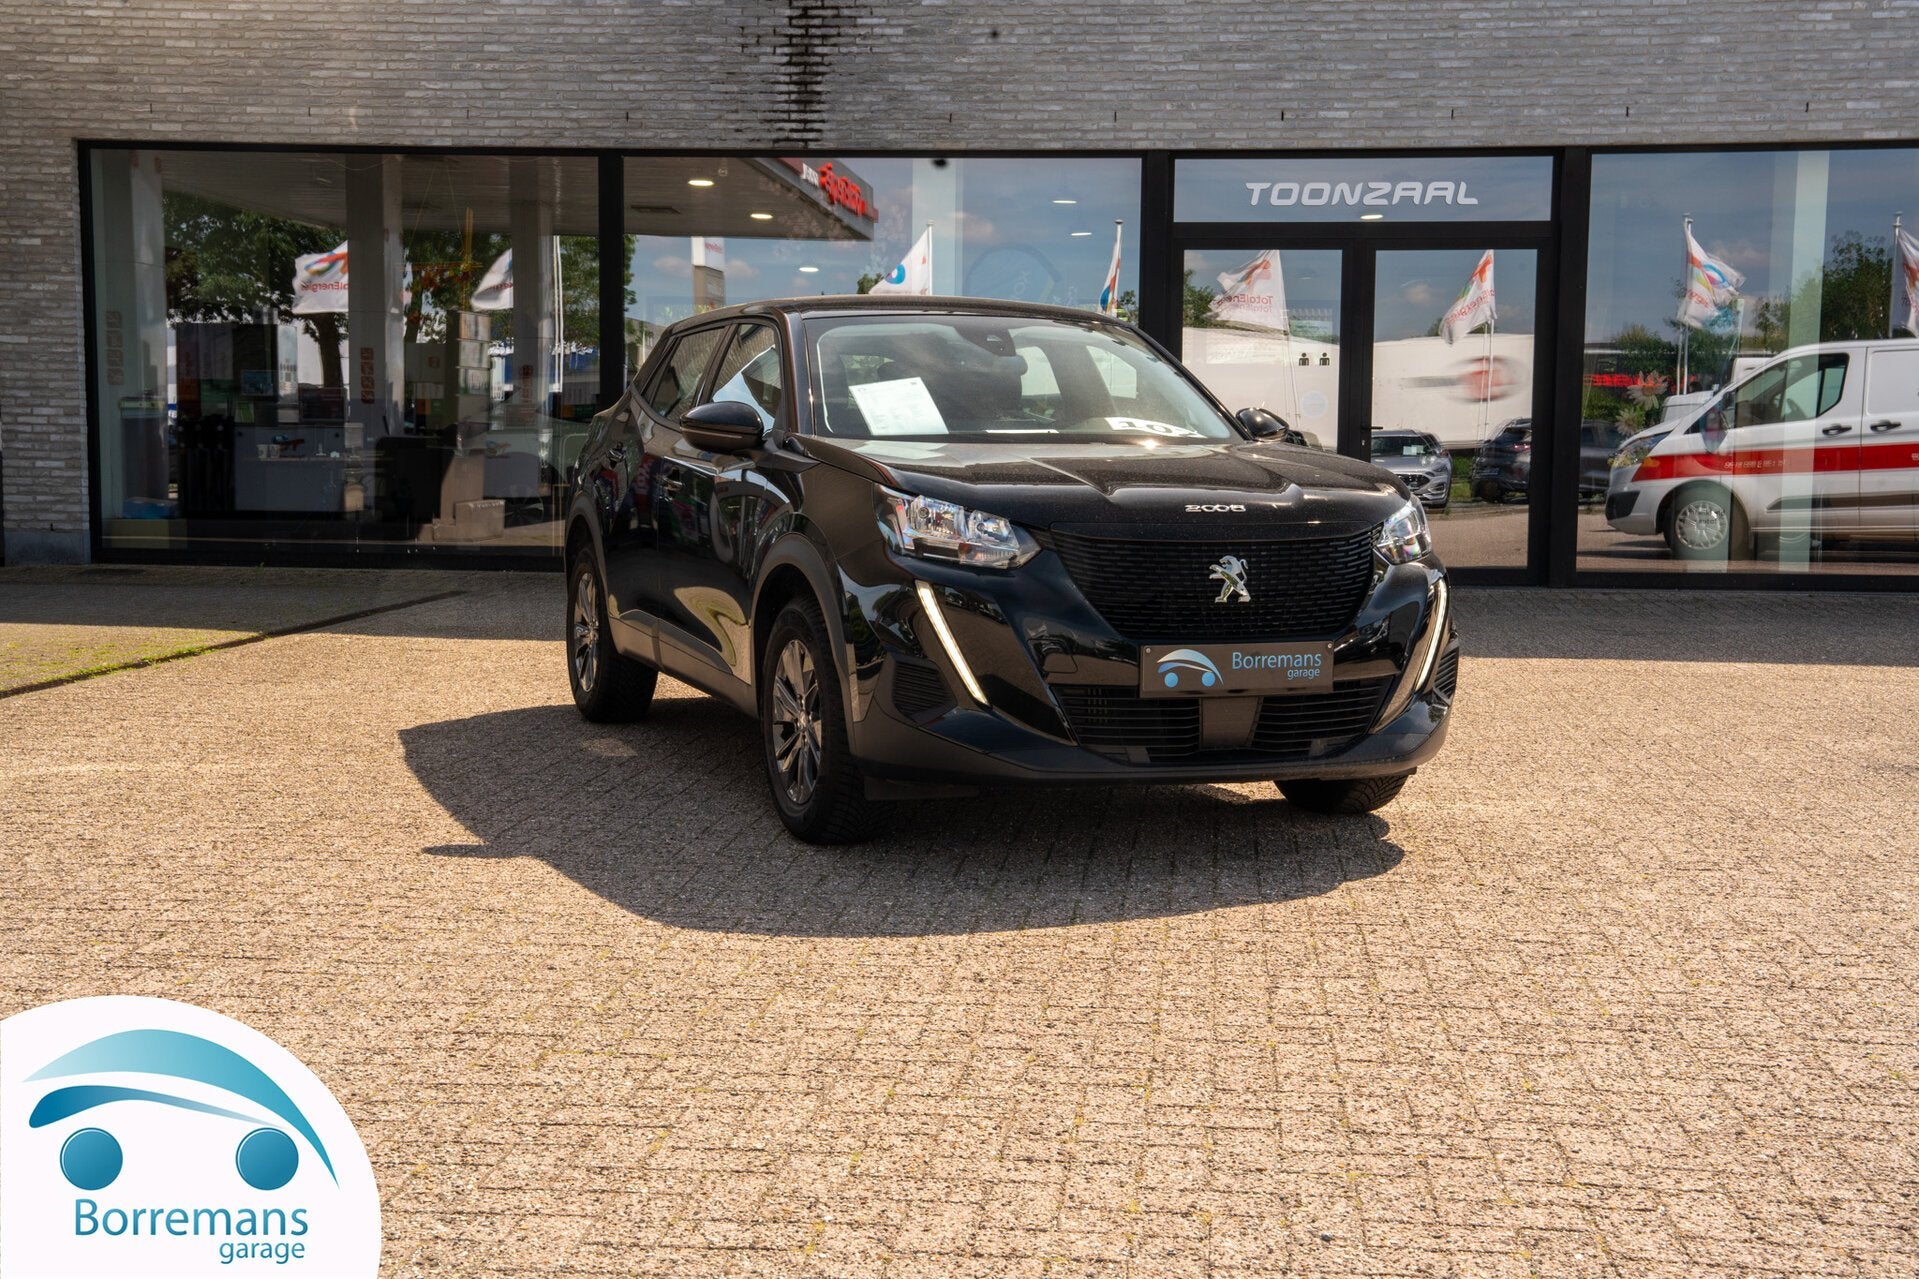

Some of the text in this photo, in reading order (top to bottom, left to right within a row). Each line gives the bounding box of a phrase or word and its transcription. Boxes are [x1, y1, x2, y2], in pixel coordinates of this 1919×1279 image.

[1245, 181, 1479, 206] TOONZAAL
[1184, 503, 1247, 513] 2008
[1231, 651, 1322, 669] Borremans
[1287, 667, 1321, 680] garage
